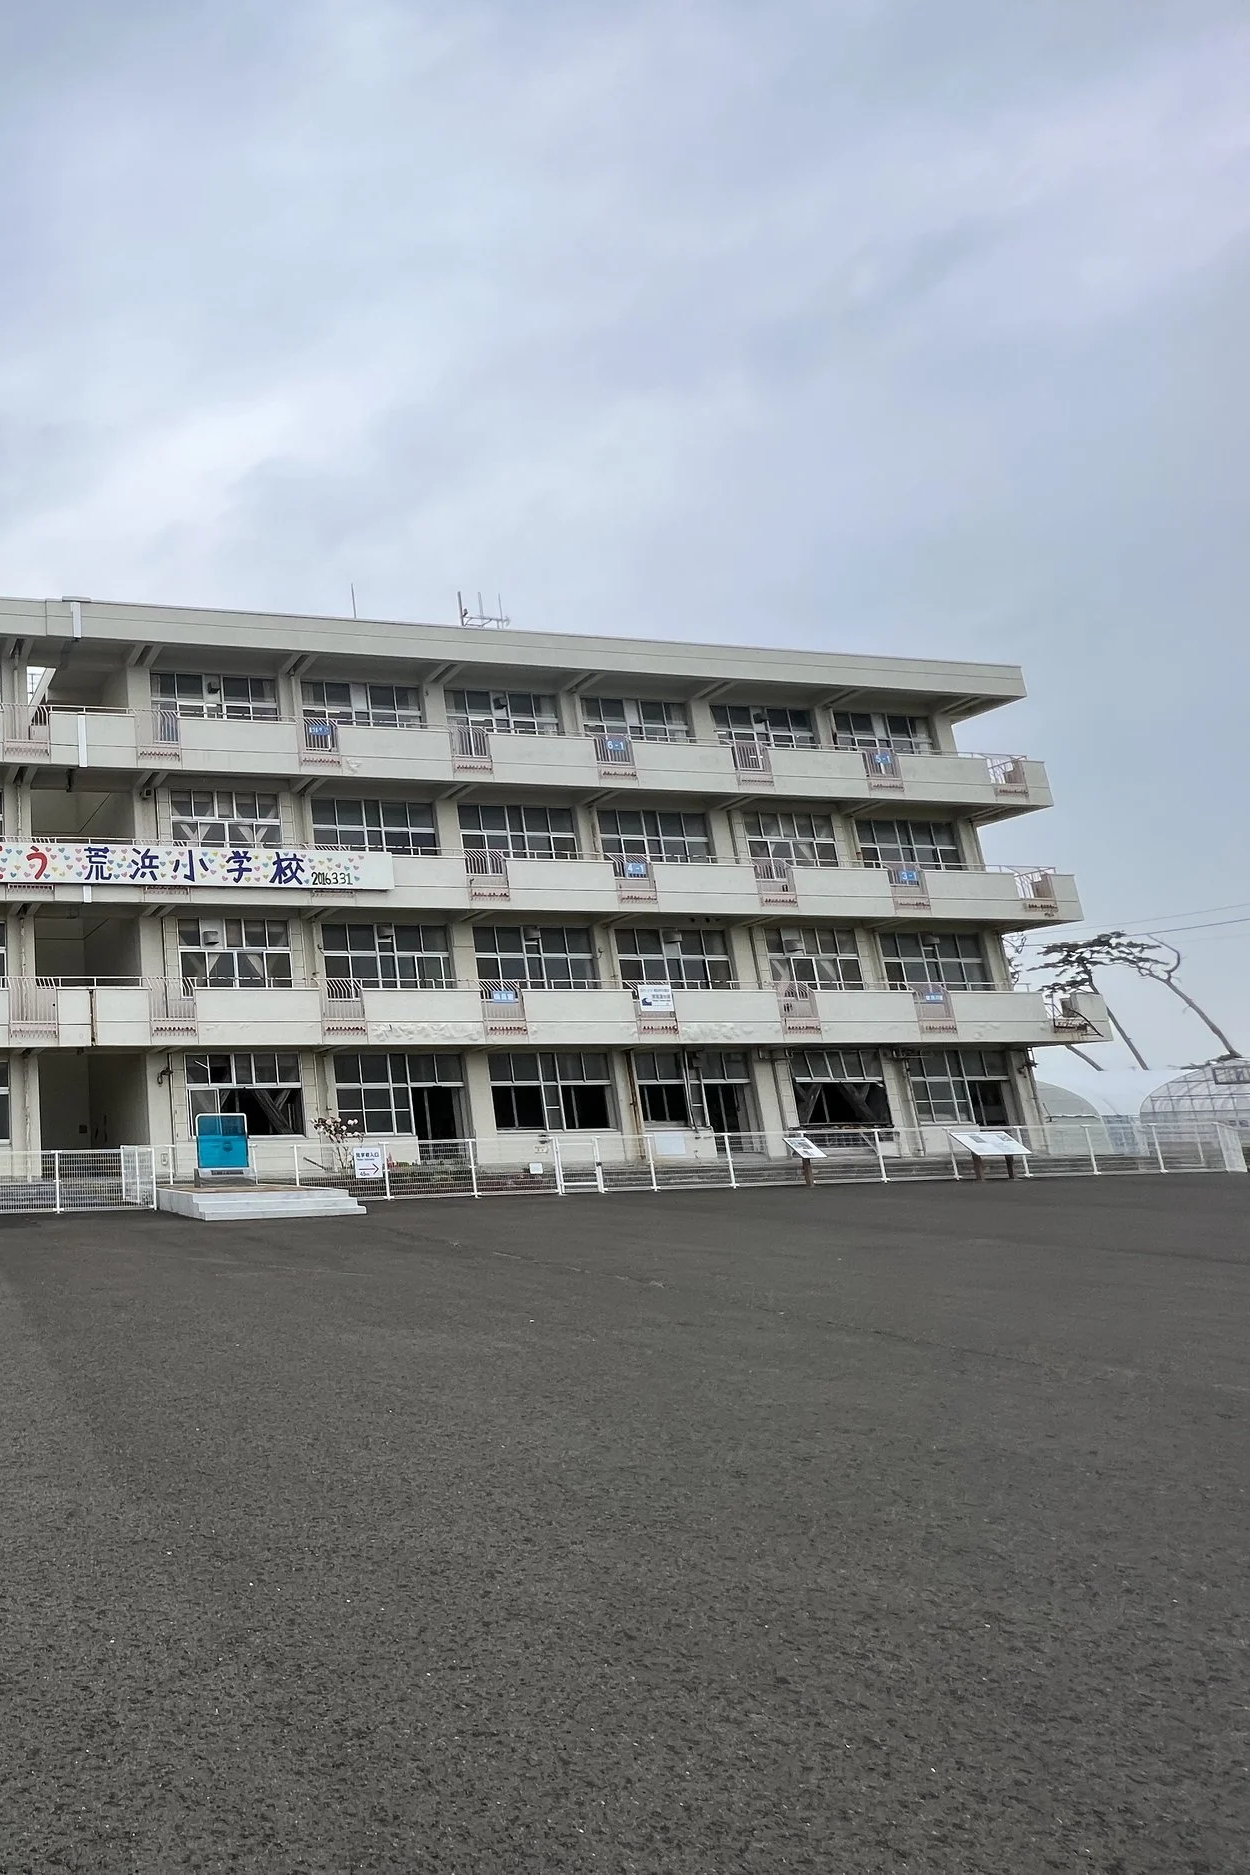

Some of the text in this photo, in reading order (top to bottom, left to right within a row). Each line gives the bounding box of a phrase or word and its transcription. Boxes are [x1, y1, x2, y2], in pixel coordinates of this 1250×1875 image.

[607, 740, 624, 750] 6-1
[84, 846, 305, 885] 荒浜小学校
[627, 863, 644, 873] 4-1
[901, 871, 917, 880] 3-1
